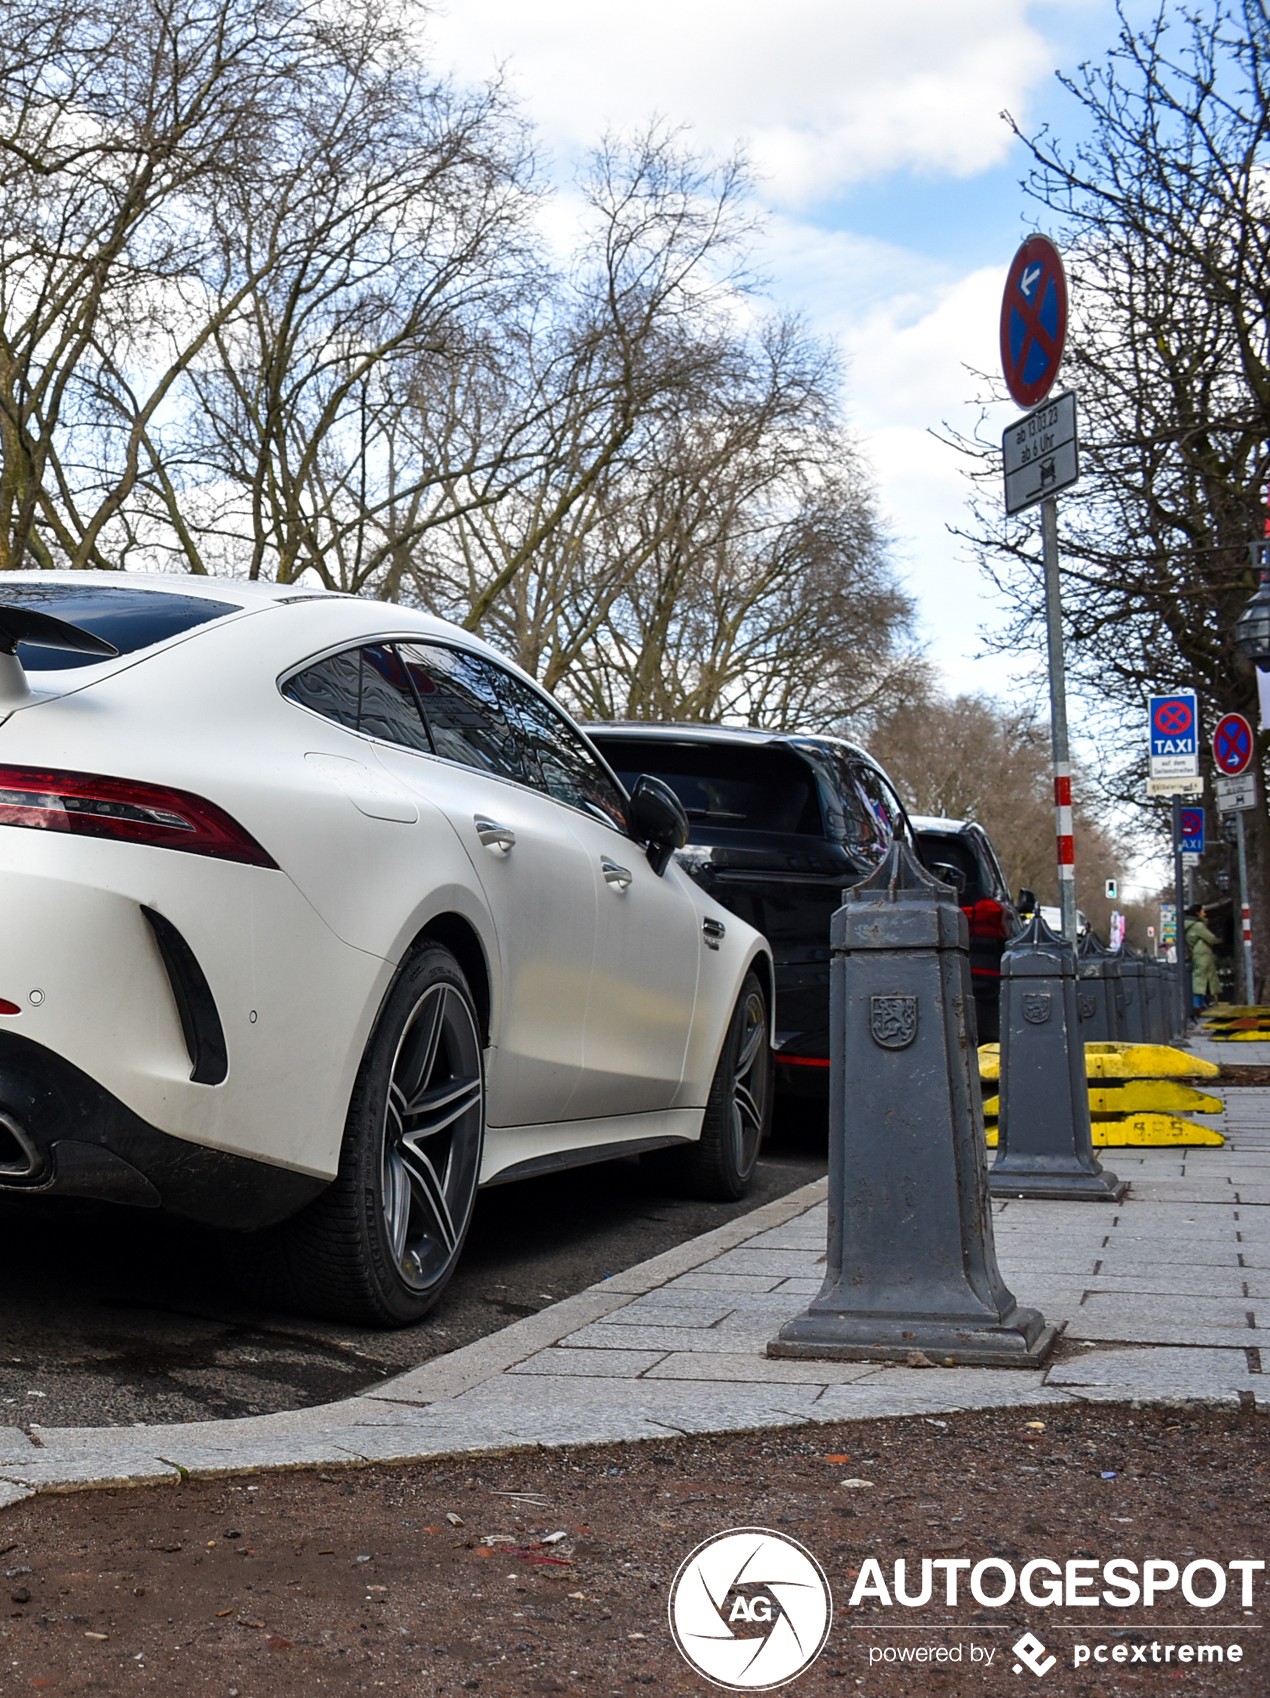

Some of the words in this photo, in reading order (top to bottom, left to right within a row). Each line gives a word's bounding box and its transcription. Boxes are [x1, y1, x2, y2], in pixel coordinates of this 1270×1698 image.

[1016, 427, 1026, 445] ab
[1028, 406, 1058, 438] 13.03.23
[1021, 445, 1030, 463] ab
[1033, 439, 1038, 456] 6
[1040, 433, 1055, 452] Uhr
[1153, 738, 1193, 754] TAXI
[1181, 839, 1201, 849] AXI
